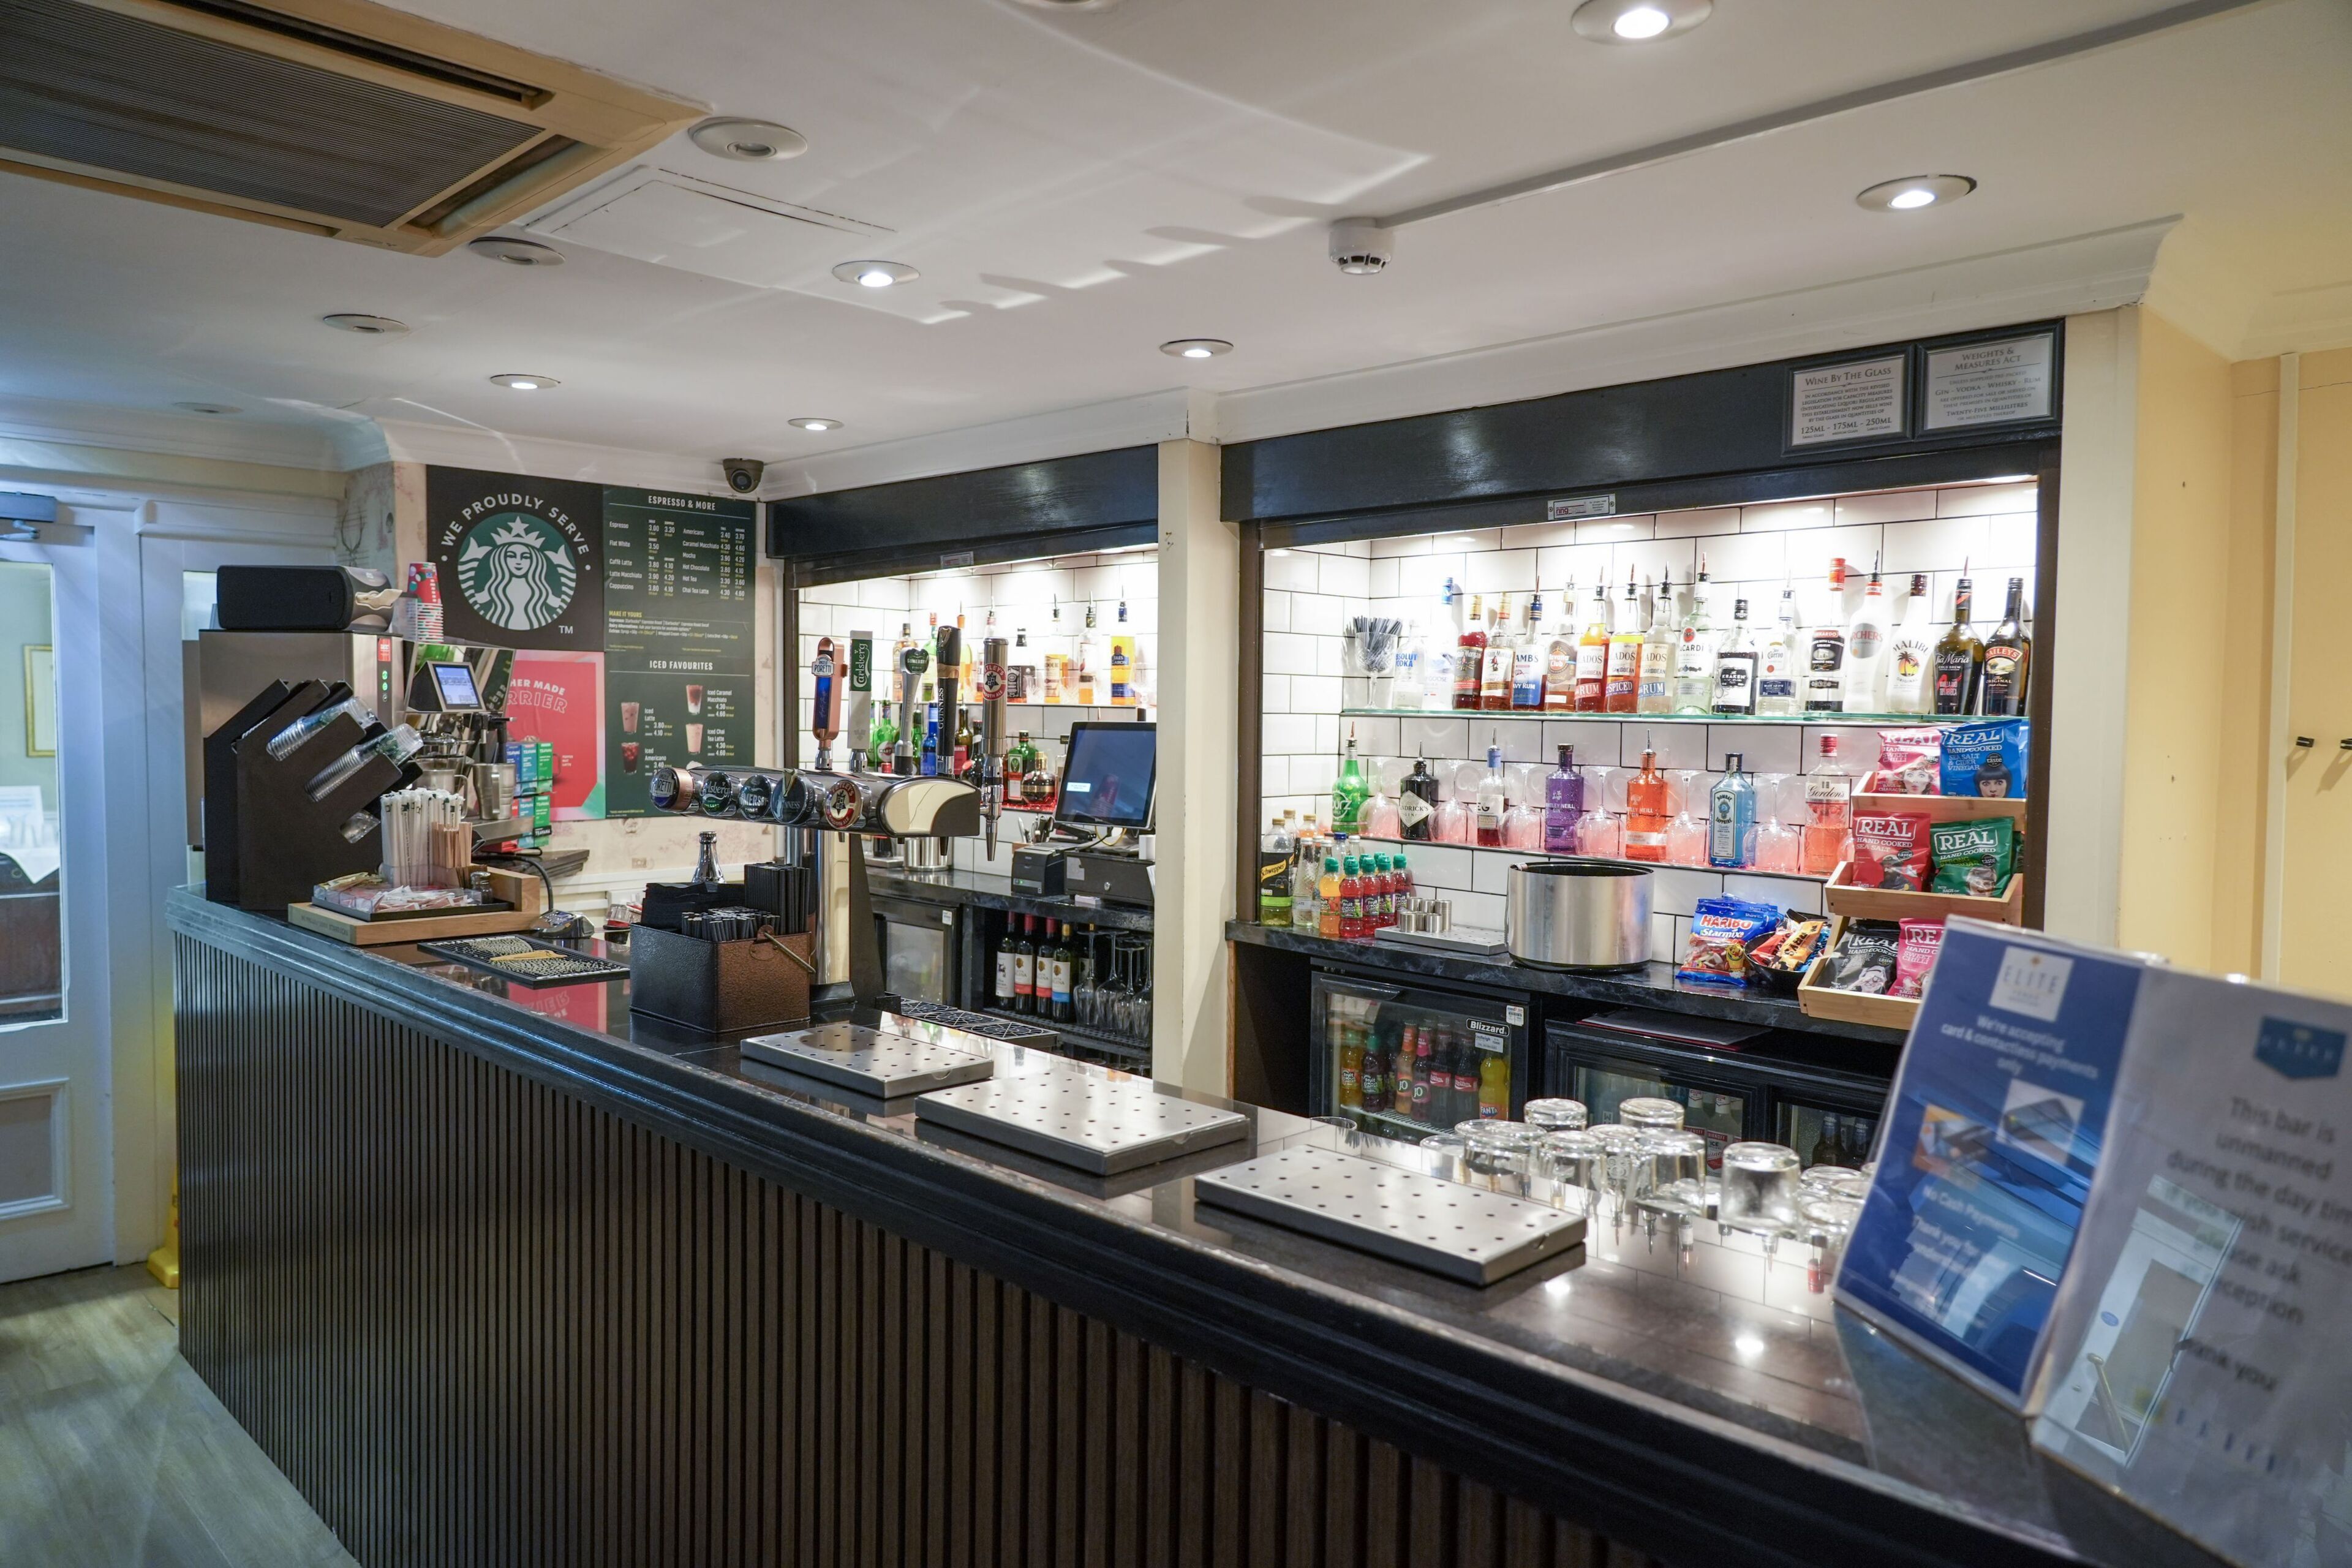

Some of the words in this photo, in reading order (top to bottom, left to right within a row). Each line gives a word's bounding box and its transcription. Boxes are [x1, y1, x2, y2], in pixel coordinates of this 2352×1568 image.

[648, 495, 685, 508] ESPRESSO
[696, 501, 715, 510] MORE
[441, 521, 463, 546] WE
[462, 493, 544, 521] PROUDLY
[548, 507, 589, 554] SERVE
[559, 625, 573, 634] TM
[1852, 631, 1883, 641] RCHERS
[1936, 653, 1945, 665] Tia
[1943, 652, 1970, 665] Maria
[1986, 648, 2019, 661] BAILEYS
[650, 660, 666, 669] ICED
[669, 661, 713, 670] FAVOURITES
[853, 643, 868, 687] Carlsberg
[533, 680, 565, 696] MADE
[1580, 684, 1600, 695] RUM
[1608, 681, 1633, 692] SPICED
[1643, 682, 1664, 693] RUM
[508, 690, 568, 714] RRIER
[1948, 730, 2000, 745] REAL
[655, 780, 672, 793] ORETTI
[1807, 785, 1845, 797] Gordon's
[1859, 820, 1912, 837] REAL
[1939, 831, 1994, 851] REAL
[1261, 864, 1284, 877] Schweppes
[1700, 914, 1753, 929] HARIBO
[1701, 928, 1740, 939] Starmix
[1902, 956, 1928, 965] CHILLI
[1904, 951, 1932, 960] SWEET
[1470, 1020, 1505, 1035] Blizzard
